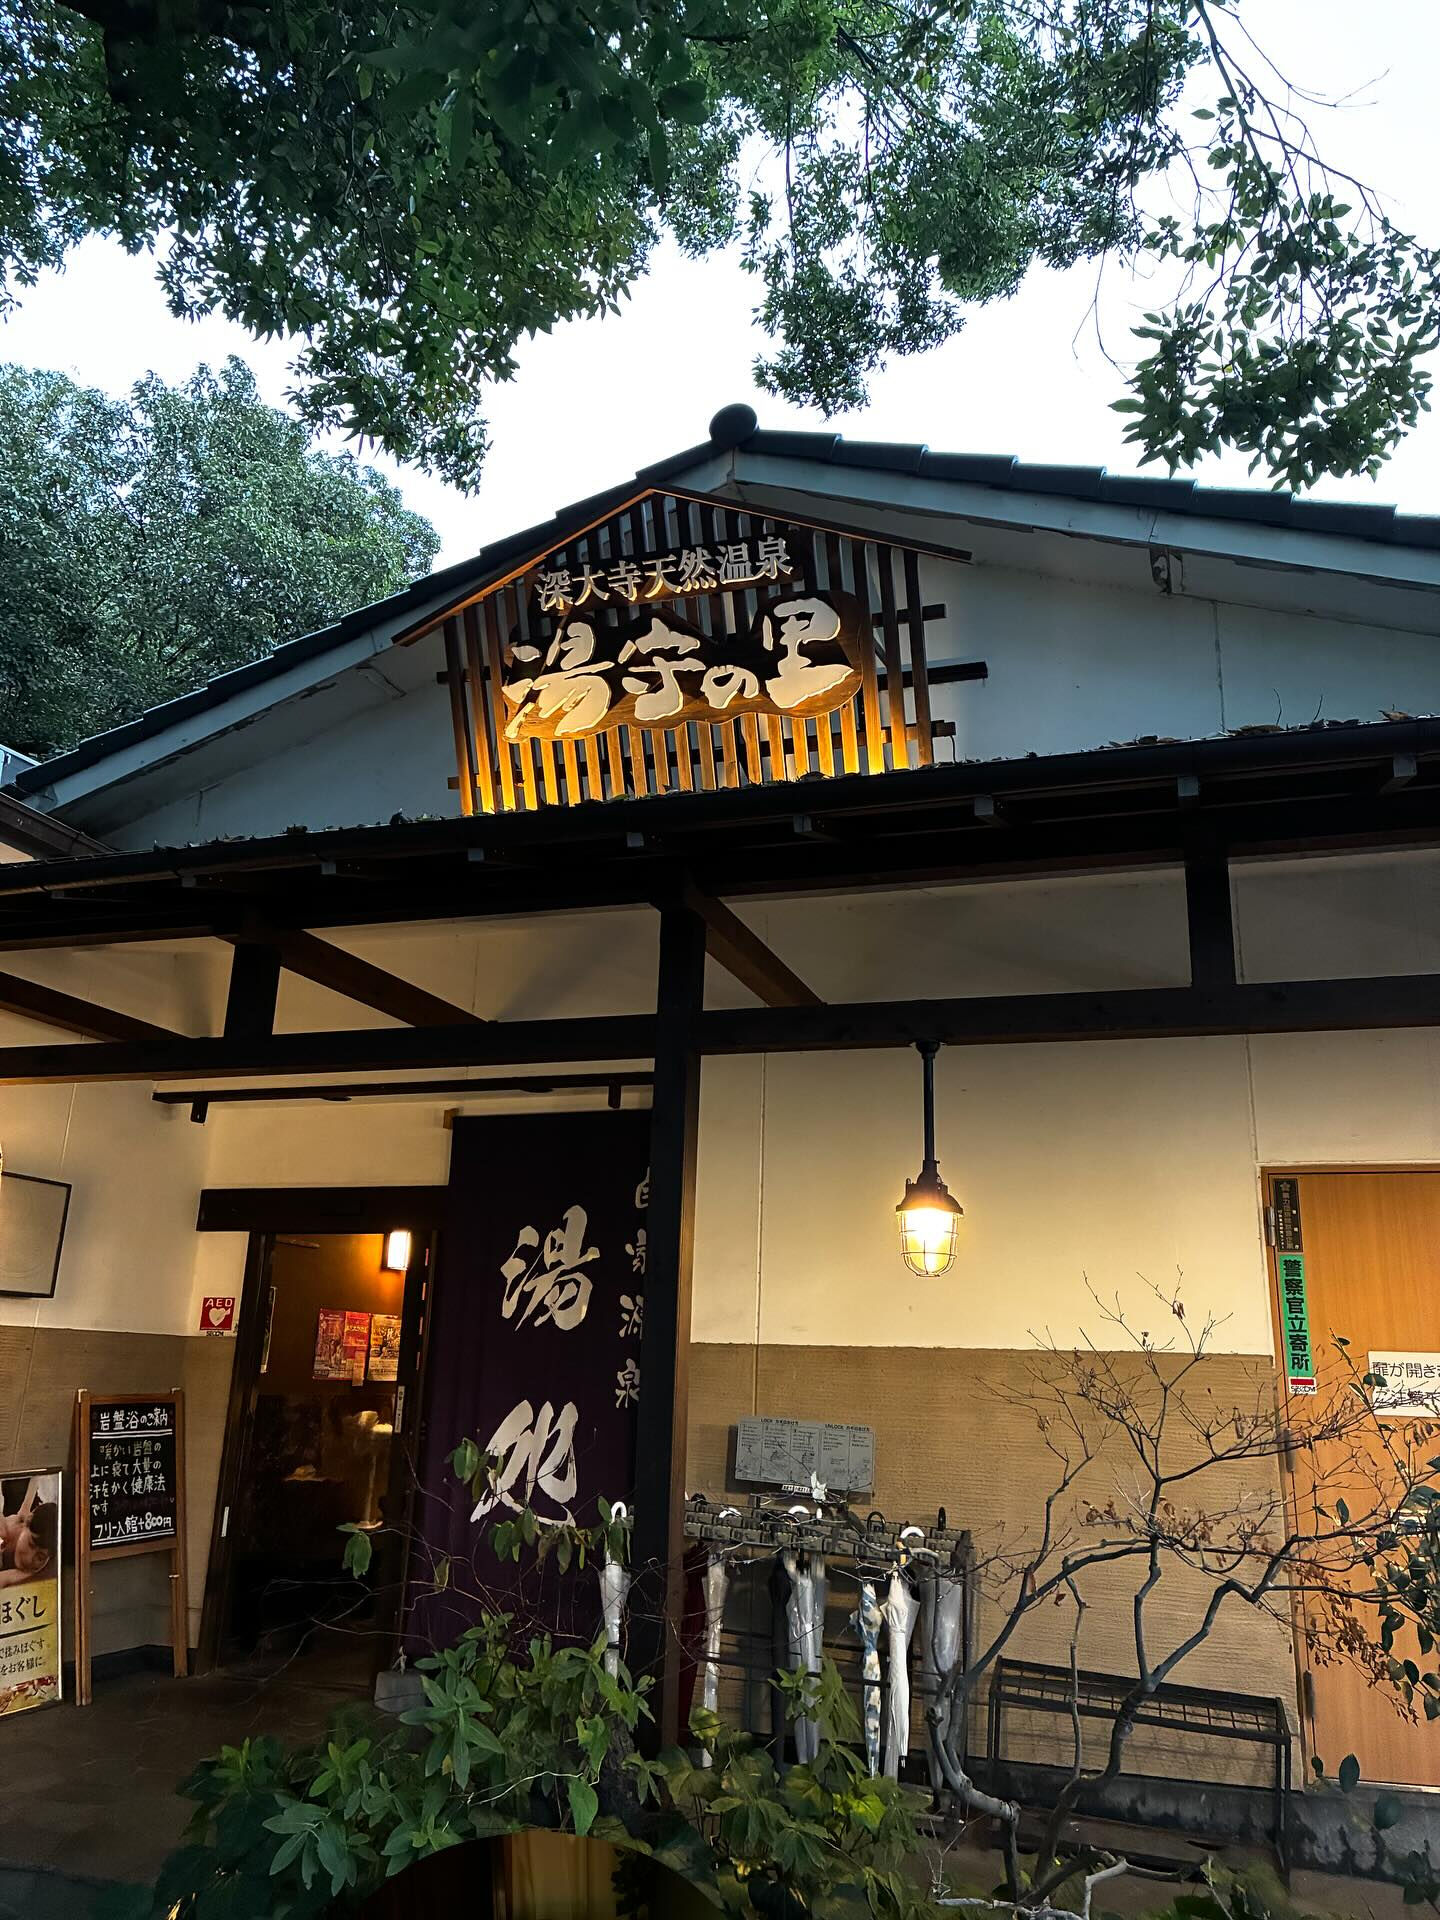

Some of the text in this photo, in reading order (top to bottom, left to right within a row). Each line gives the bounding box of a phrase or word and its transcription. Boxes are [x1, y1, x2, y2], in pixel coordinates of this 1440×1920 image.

[535, 536, 793, 611] 深大寺天然温泉
[502, 597, 855, 740] 湯守の里
[205, 1298, 233, 1307] AED
[1283, 1258, 1310, 1372] 警察官立寄所
[100, 1407, 169, 1431] 岩盤浴のご案内
[89, 1473, 166, 1500] 汗をかく健康法
[91, 1501, 109, 1517] です
